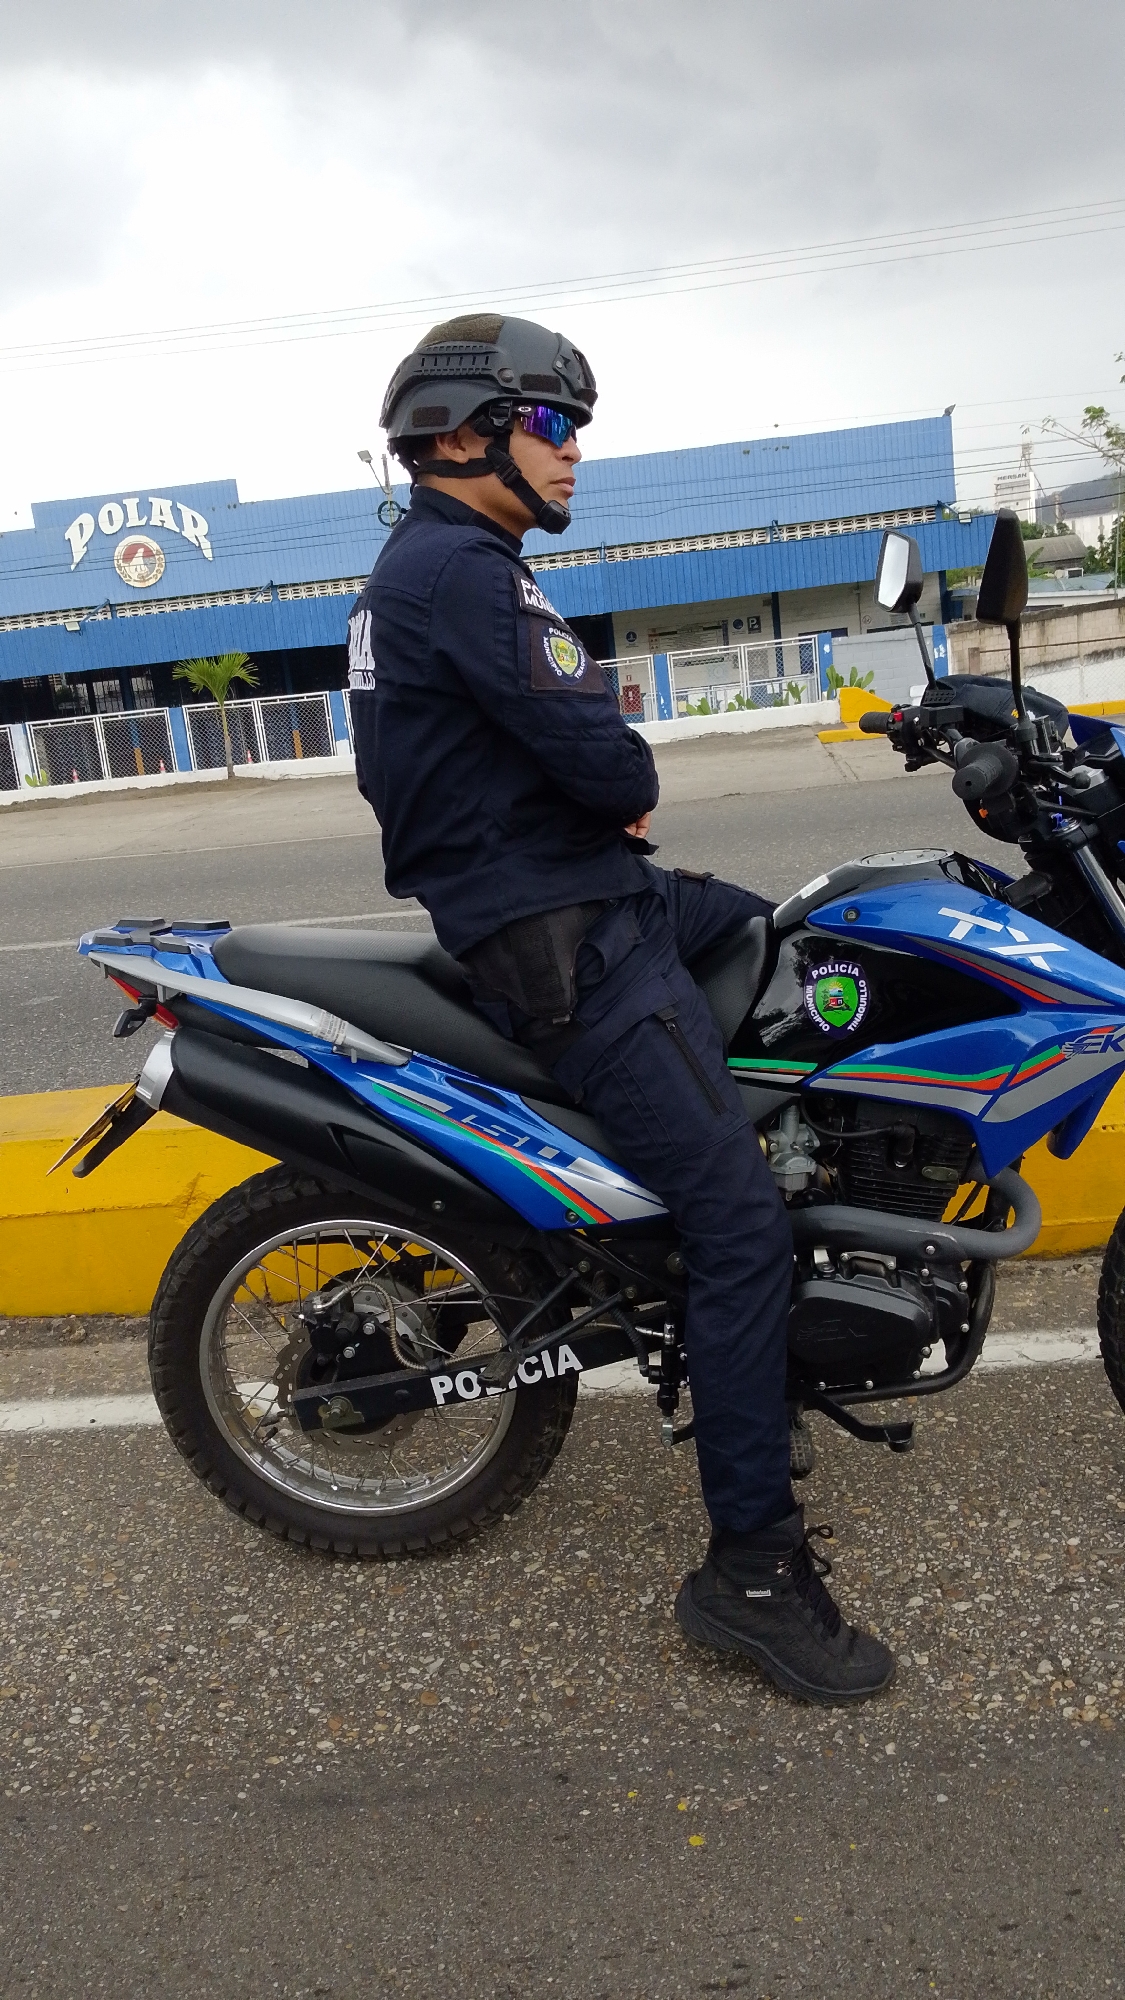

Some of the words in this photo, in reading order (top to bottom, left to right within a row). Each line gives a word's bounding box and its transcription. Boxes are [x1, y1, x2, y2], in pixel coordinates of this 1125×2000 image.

[997, 472, 1027, 481] MERSAN
[64, 497, 214, 571] POLAR
[542, 636, 563, 677] MUNICIPIO
[811, 963, 859, 980] POLICÍA
[805, 985, 831, 1032] MUNICIPIO
[846, 979, 868, 1032] TINAQUILLO
